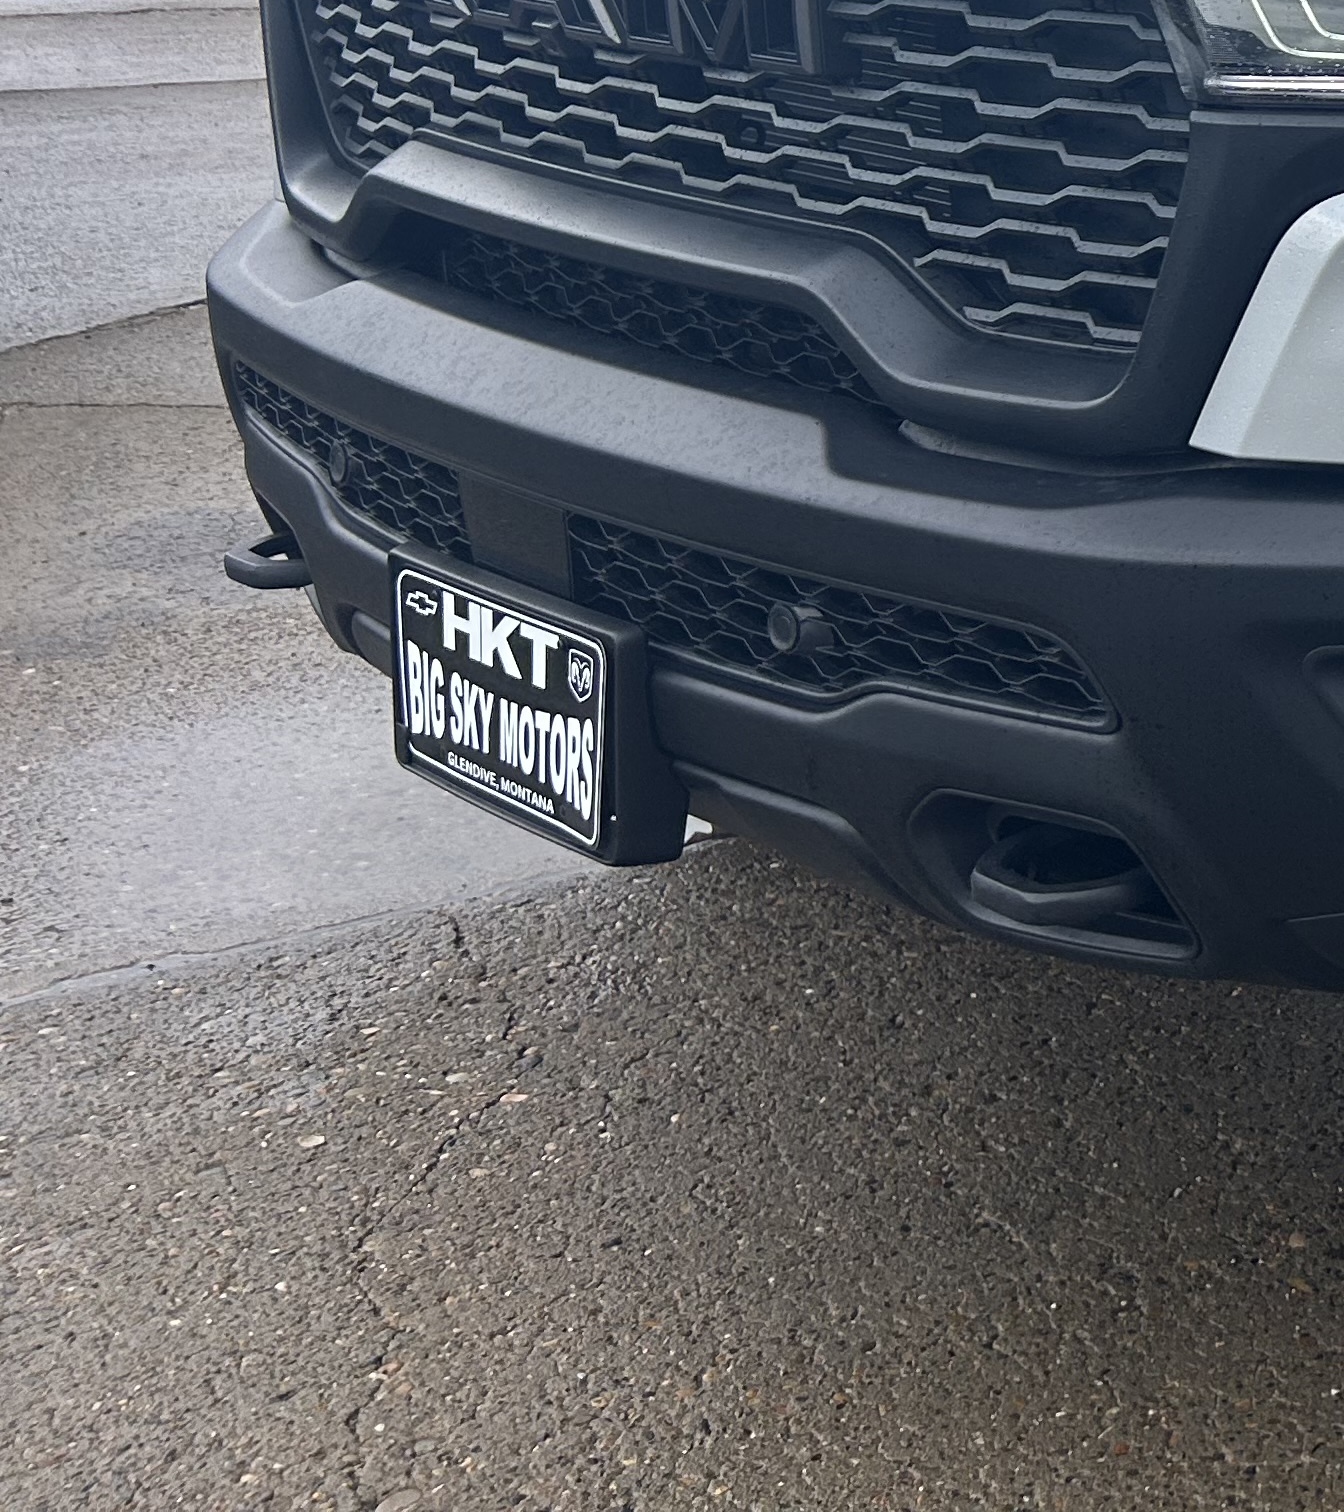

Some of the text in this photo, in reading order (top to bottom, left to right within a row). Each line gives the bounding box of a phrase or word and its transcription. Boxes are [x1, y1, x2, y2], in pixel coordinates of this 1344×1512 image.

[441, 590, 560, 690] HKT
[406, 639, 594, 821] BIG SKY MOTORS
[447, 751, 555, 815] GLENDIVE, MONTANA
